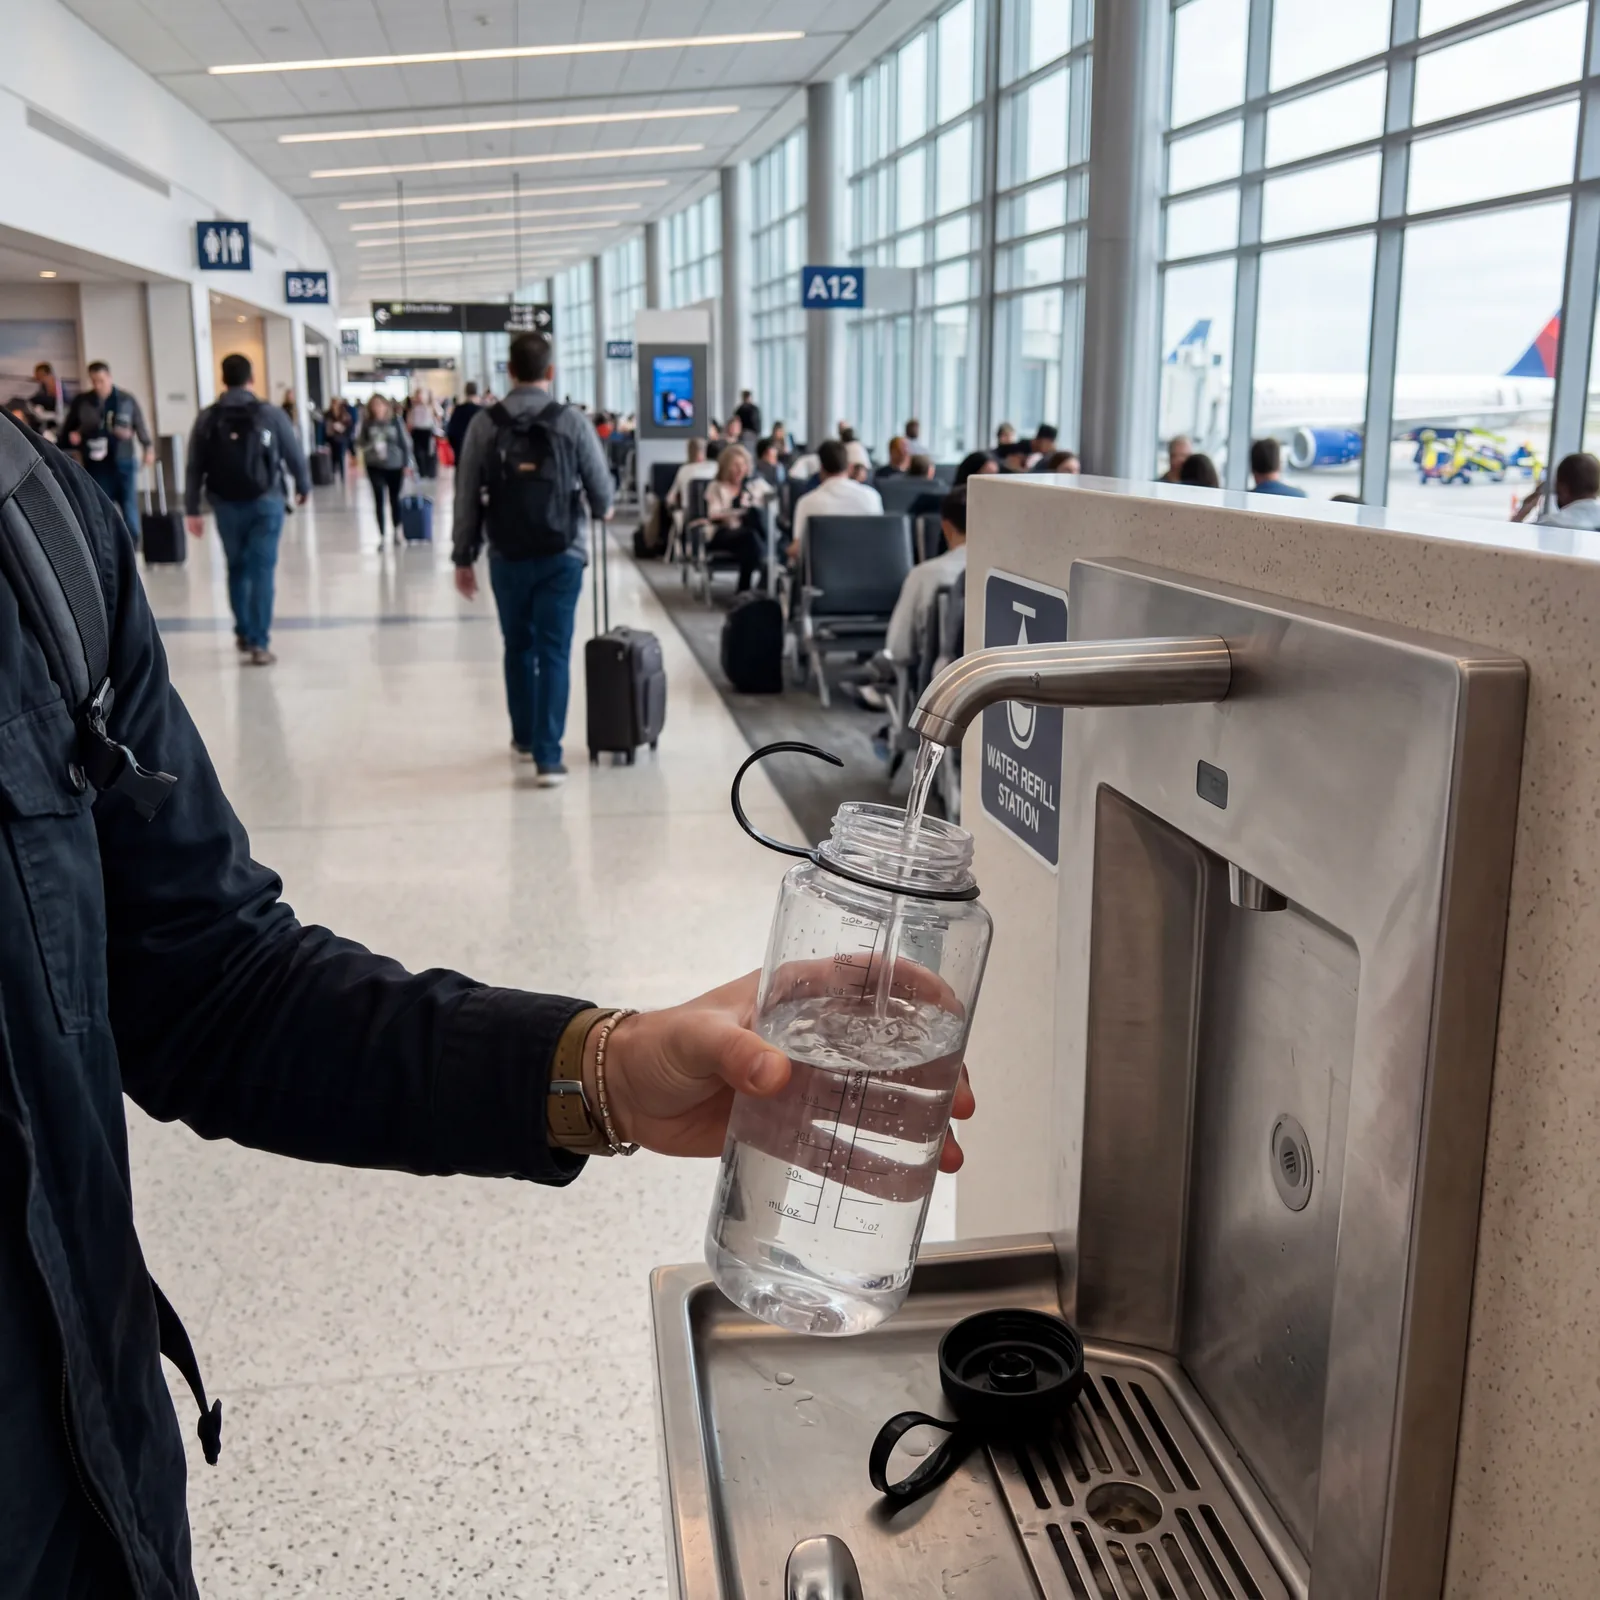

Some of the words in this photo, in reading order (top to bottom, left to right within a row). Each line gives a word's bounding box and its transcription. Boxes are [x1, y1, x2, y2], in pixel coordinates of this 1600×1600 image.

[287, 277, 327, 297] B34
[807, 274, 857, 300] A12
[987, 743, 1019, 785] WATER
[1020, 766, 1056, 812] REFILL
[998, 782, 1040, 834] STATION
